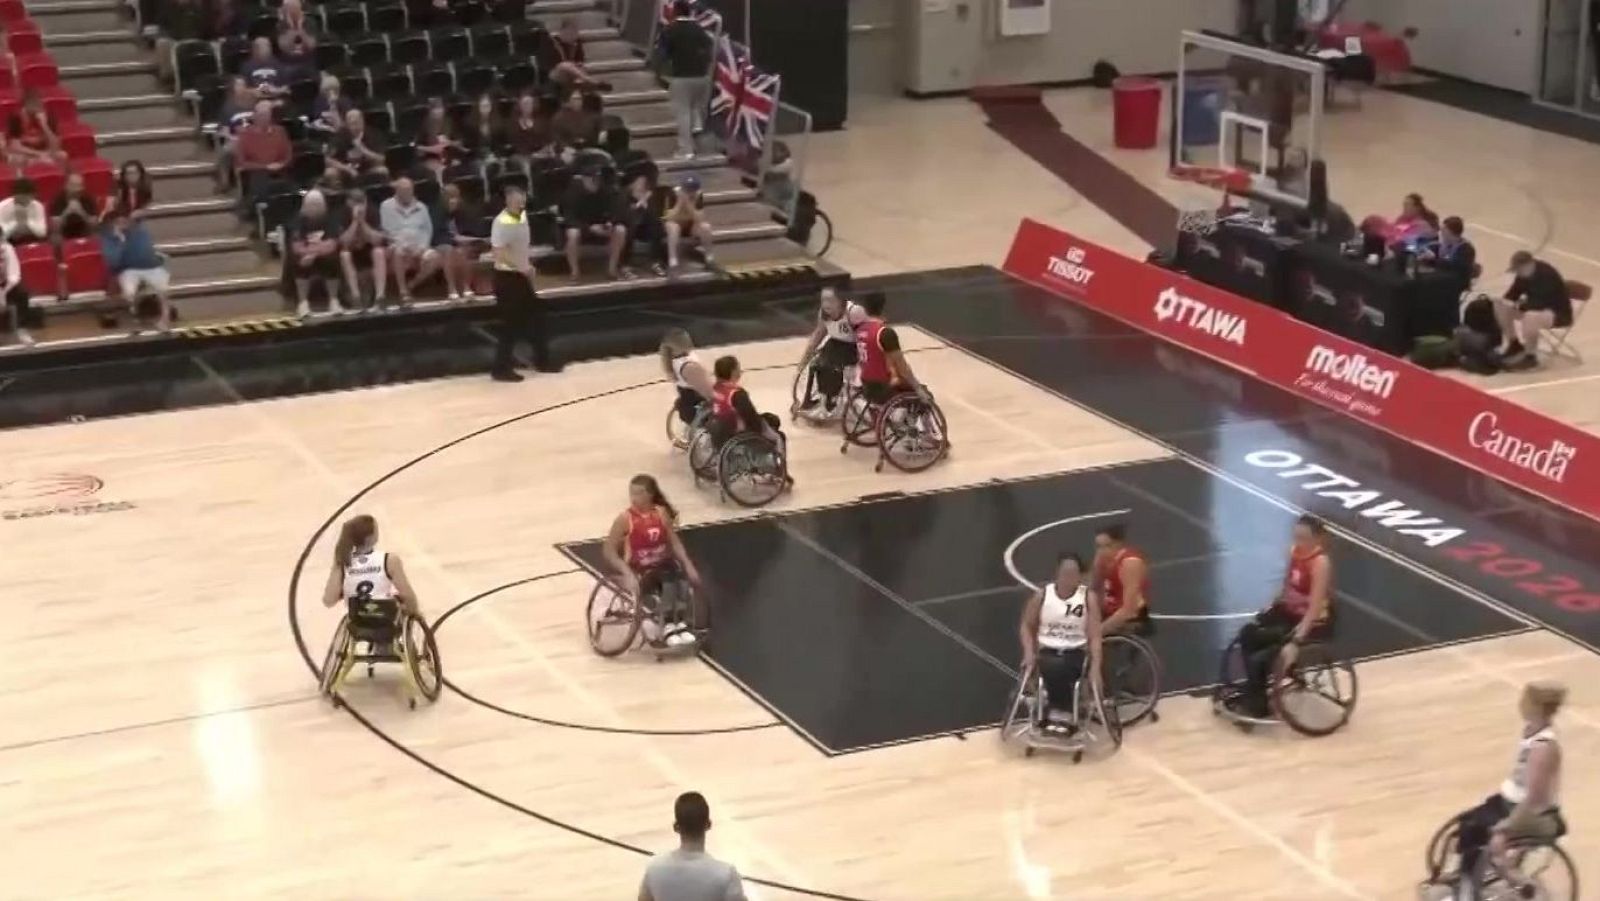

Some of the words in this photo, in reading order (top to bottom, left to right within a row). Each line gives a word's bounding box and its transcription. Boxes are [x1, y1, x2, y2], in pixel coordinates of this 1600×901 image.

[1047, 256, 1094, 284] TISSOT
[1153, 287, 1247, 345] OTTAWA
[1306, 344, 1395, 398] molten
[1468, 410, 1568, 483] Canada
[1244, 449, 1467, 547] OTTAWA
[1064, 603, 1084, 618] 14
